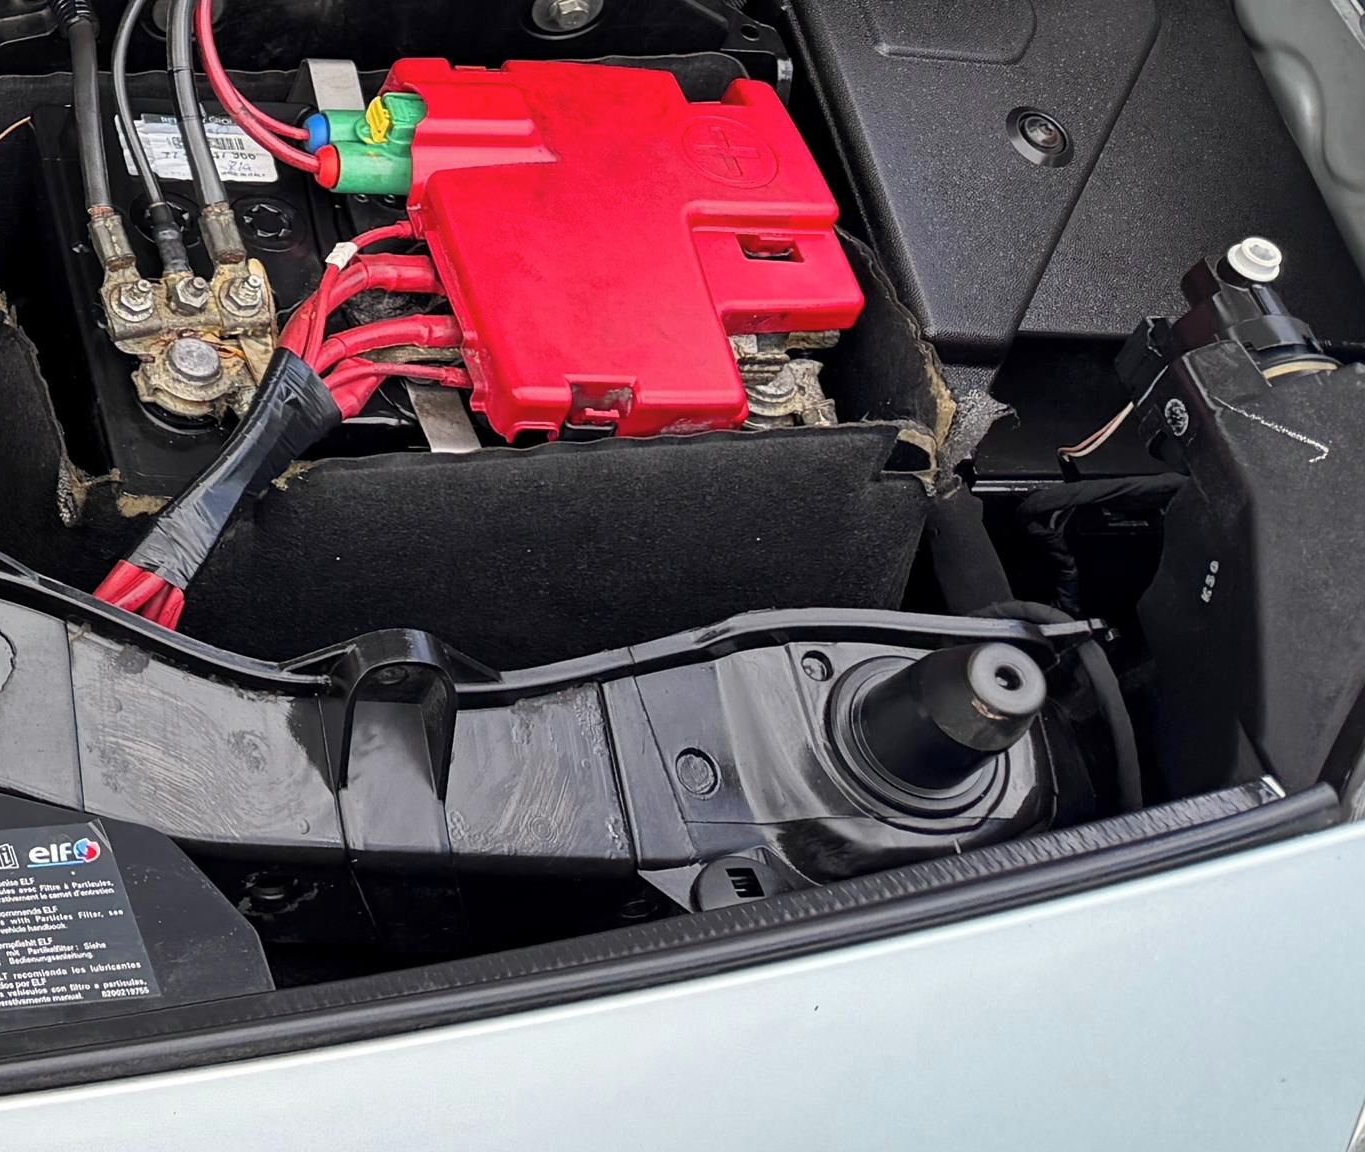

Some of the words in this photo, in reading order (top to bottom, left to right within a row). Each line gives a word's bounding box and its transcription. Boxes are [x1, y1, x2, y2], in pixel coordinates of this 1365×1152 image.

[28, 842, 73, 863] elf
[20, 877, 35, 885] ELF
[43, 905, 58, 914] ELF
[38, 937, 53, 945] ELF
